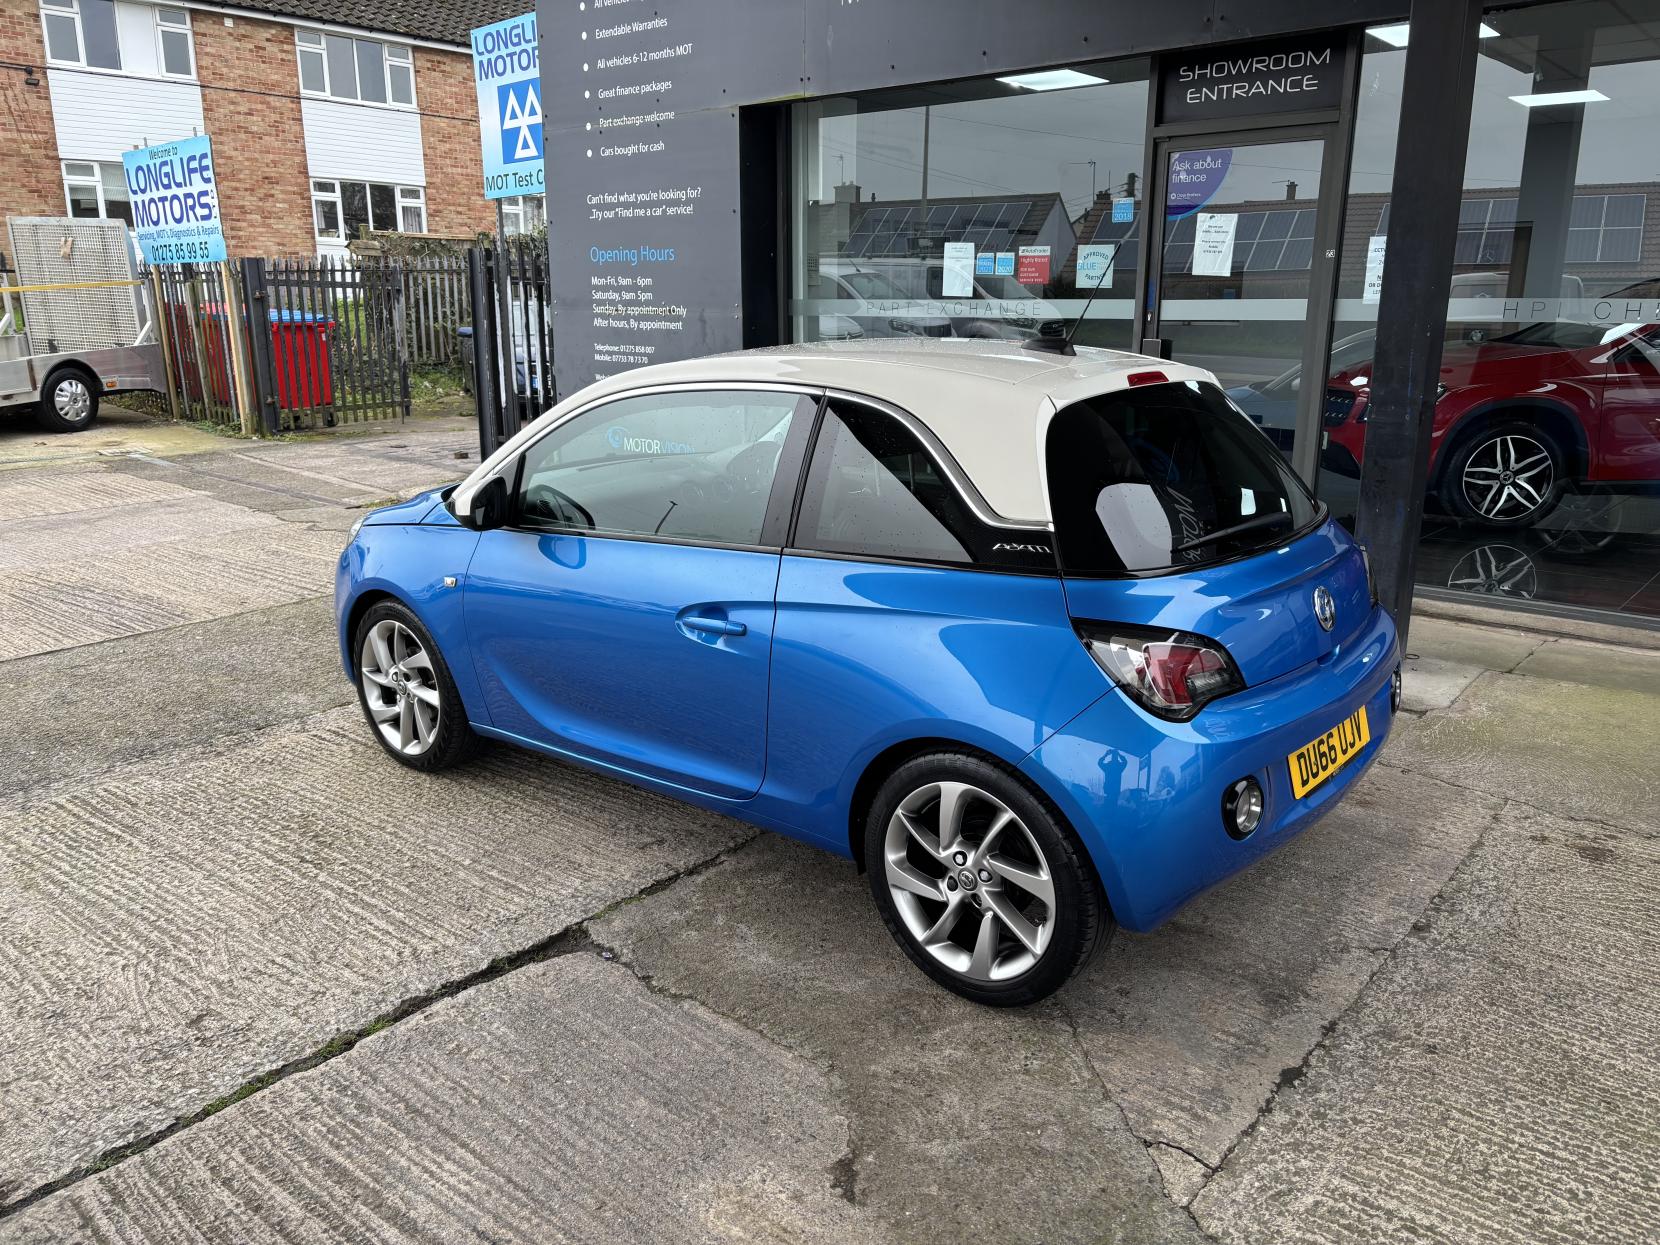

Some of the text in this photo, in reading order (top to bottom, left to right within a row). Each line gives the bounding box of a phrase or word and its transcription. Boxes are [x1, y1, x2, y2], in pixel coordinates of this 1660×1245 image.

[595, 17, 668, 39] Extendable Warranties
[474, 20, 537, 57] LONGLI
[597, 43, 693, 69] All vehicles 6-12 months MOT
[1178, 48, 1331, 82] SHOWROOM
[598, 80, 672, 99] Great finance packages
[1186, 74, 1319, 104] ENTRANCE
[599, 111, 675, 128] Part exchange welcome
[149, 146, 178, 161] Welcome to
[600, 140, 665, 157] Cars bought for cash
[1172, 158, 1222, 171] Ask about
[126, 152, 212, 195] LONGLIFE
[486, 169, 545, 192] MOT Test C
[1172, 173, 1207, 184] finance
[586, 186, 701, 205] Can't find what you're looking for?
[134, 190, 213, 228] MOTORS
[603, 210, 615, 218] our
[634, 209, 645, 217] me
[666, 203, 694, 215] service!
[170, 227, 196, 240] Diagnostics
[197, 226, 201, 236] &
[151, 241, 210, 261] 01275 85 99 55
[590, 246, 675, 266] Opening Hours
[1083, 251, 1109, 261] APPROVED
[1077, 262, 1097, 271] BLUE
[591, 276, 617, 286] Mon-Fri,
[617, 276, 632, 286] 9am
[637, 276, 653, 287] 6pm
[1085, 273, 1104, 281] PARTN
[592, 290, 653, 302] Saturday, 9am 5pm
[592, 303, 687, 318] Sunday, By appointment Only
[866, 302, 1041, 316] PART EXCHANGE
[1503, 302, 1562, 319] HPI
[593, 317, 683, 331] After hours, By appointment
[1296, 710, 1362, 788] DU66 UJV
